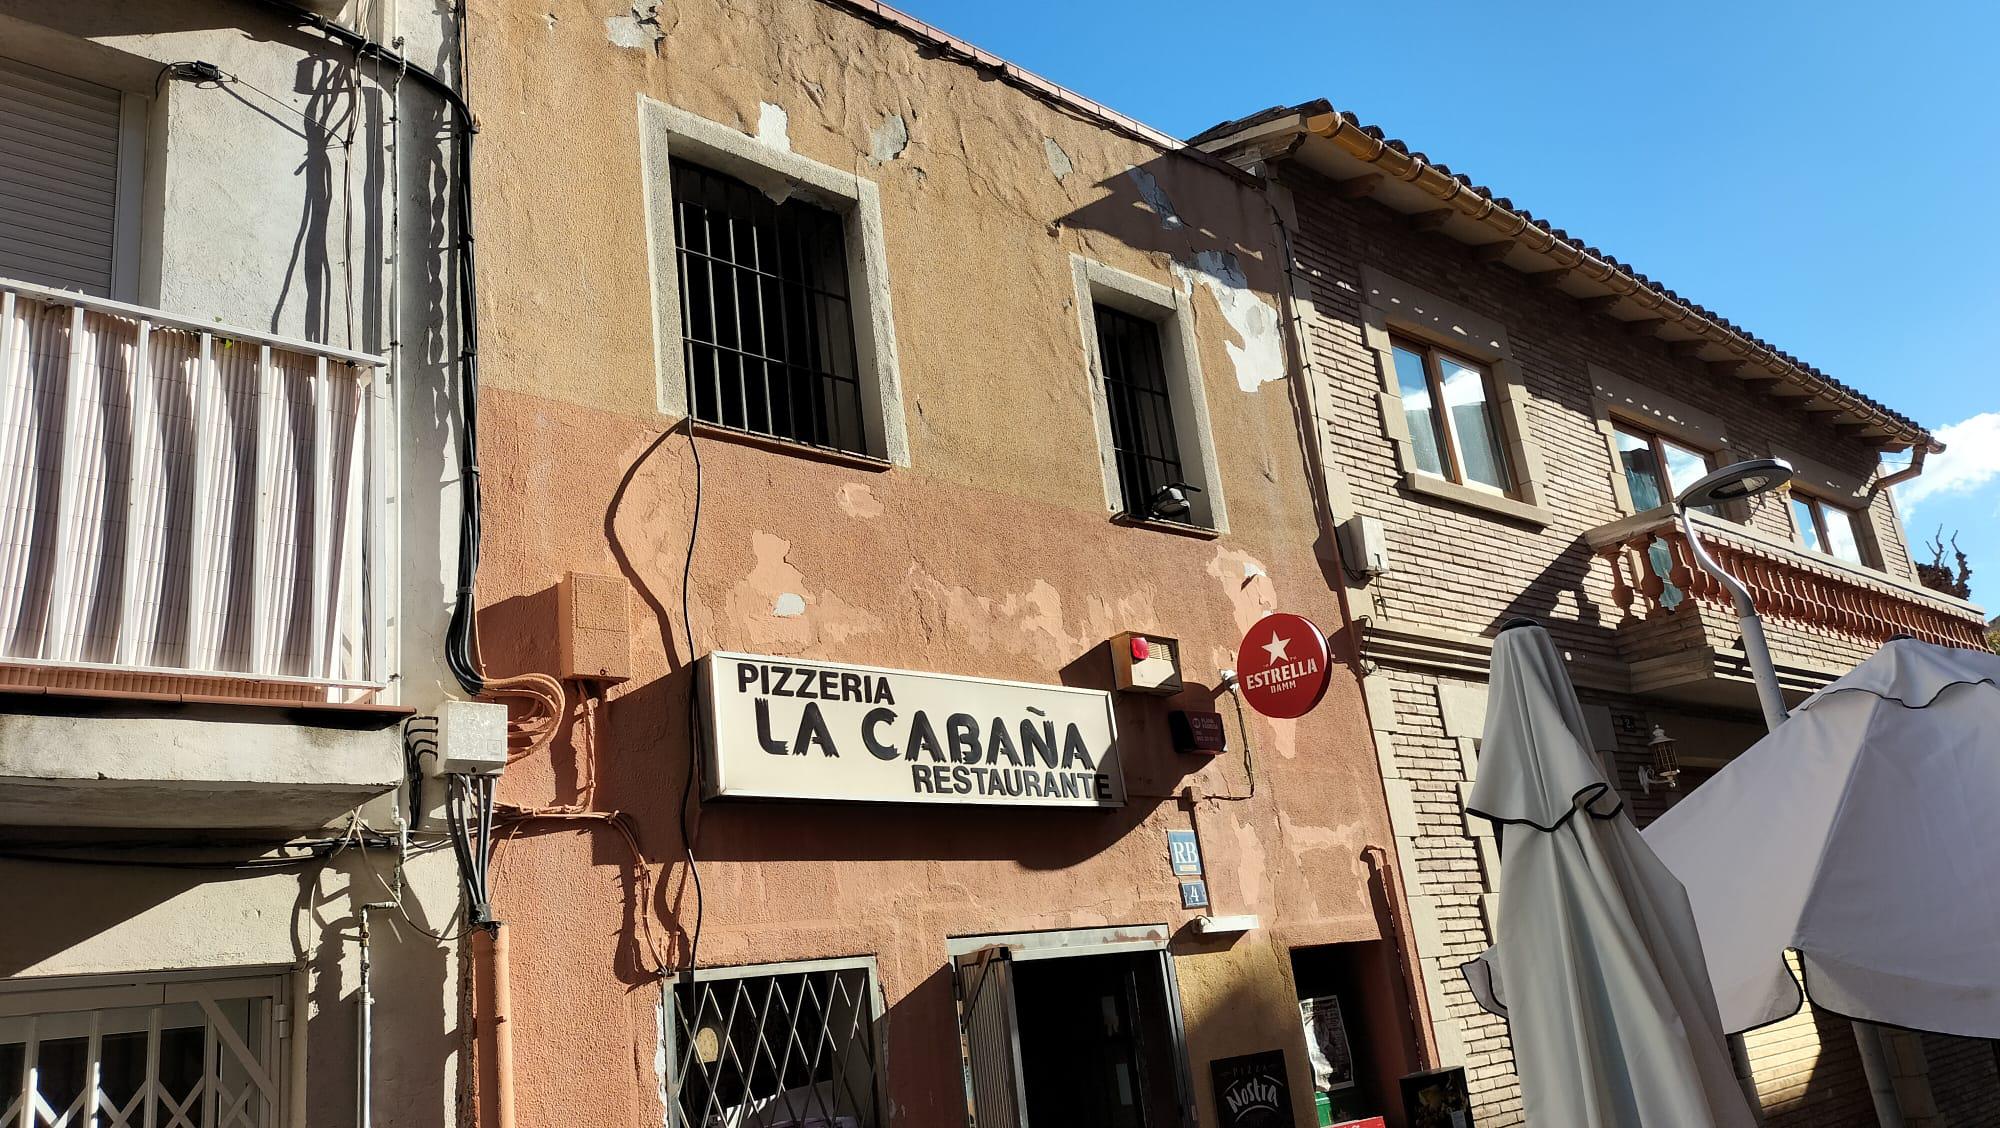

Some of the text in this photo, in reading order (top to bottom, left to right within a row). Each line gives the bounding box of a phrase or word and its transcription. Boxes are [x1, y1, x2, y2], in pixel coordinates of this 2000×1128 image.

[737, 663, 895, 705] PIZZERIA
[1246, 658, 1318, 690] ESTRELLA
[1270, 680, 1297, 694] DAMM
[754, 697, 1097, 771] LA CABAÑA
[912, 765, 1113, 799] RESTAURANTE
[1172, 841, 1198, 864] RB
[1226, 1078, 1279, 1114] Nostra
